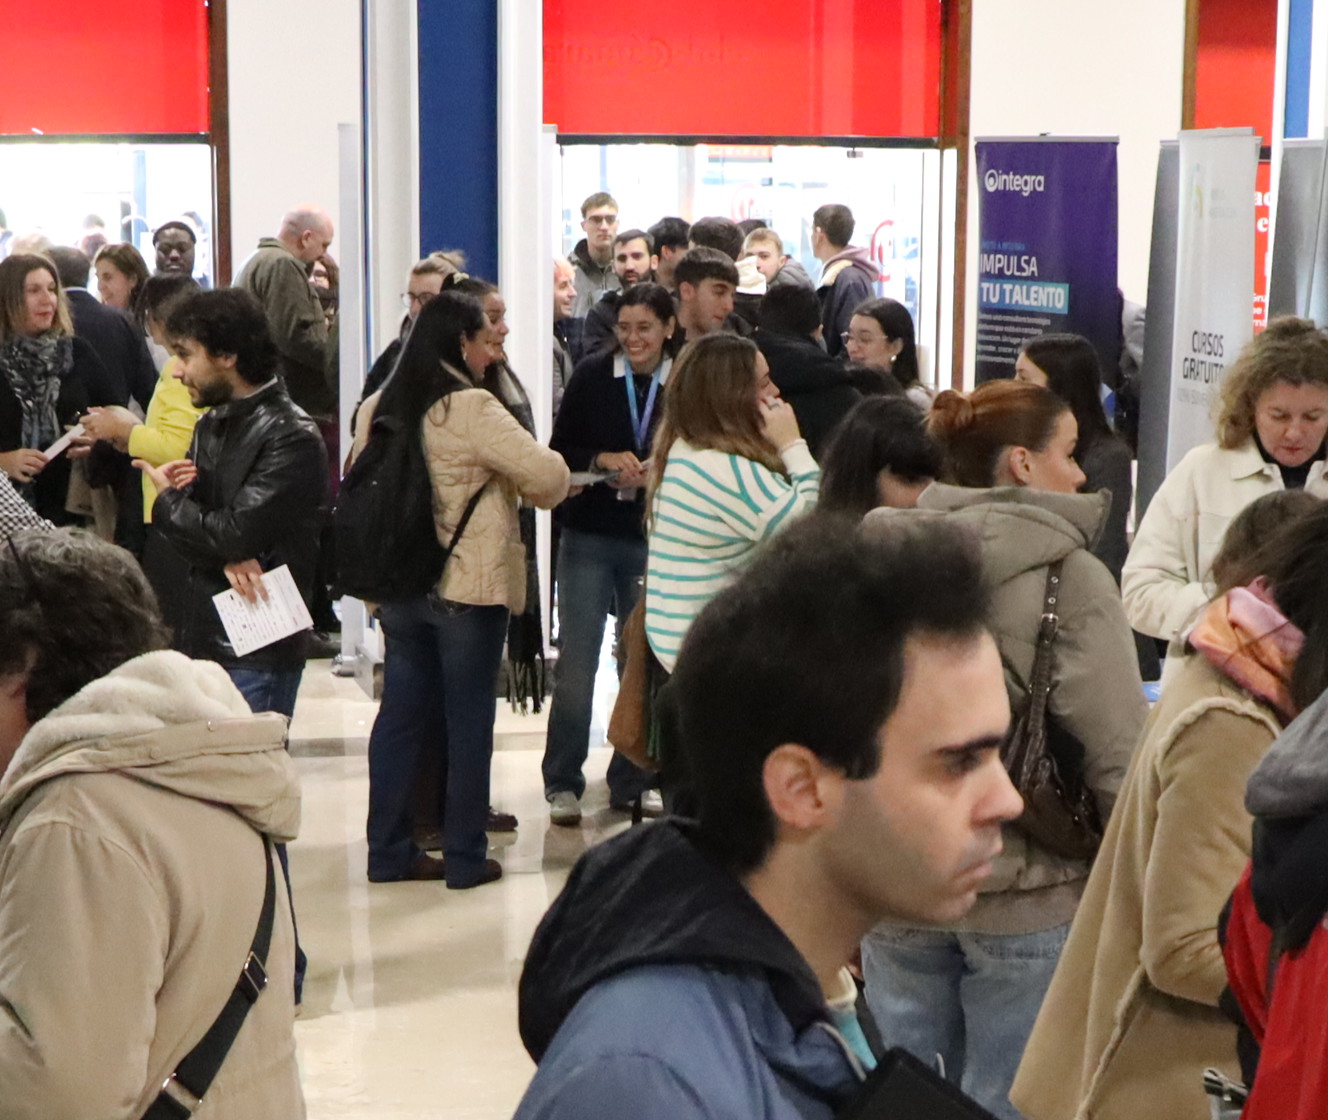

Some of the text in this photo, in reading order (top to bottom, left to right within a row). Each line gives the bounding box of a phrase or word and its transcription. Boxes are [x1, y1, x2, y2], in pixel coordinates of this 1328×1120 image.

[980, 253, 1039, 277] IMPULSA
[981, 282, 1065, 309] TU TALENTO
[1192, 330, 1224, 358] CURSOS
